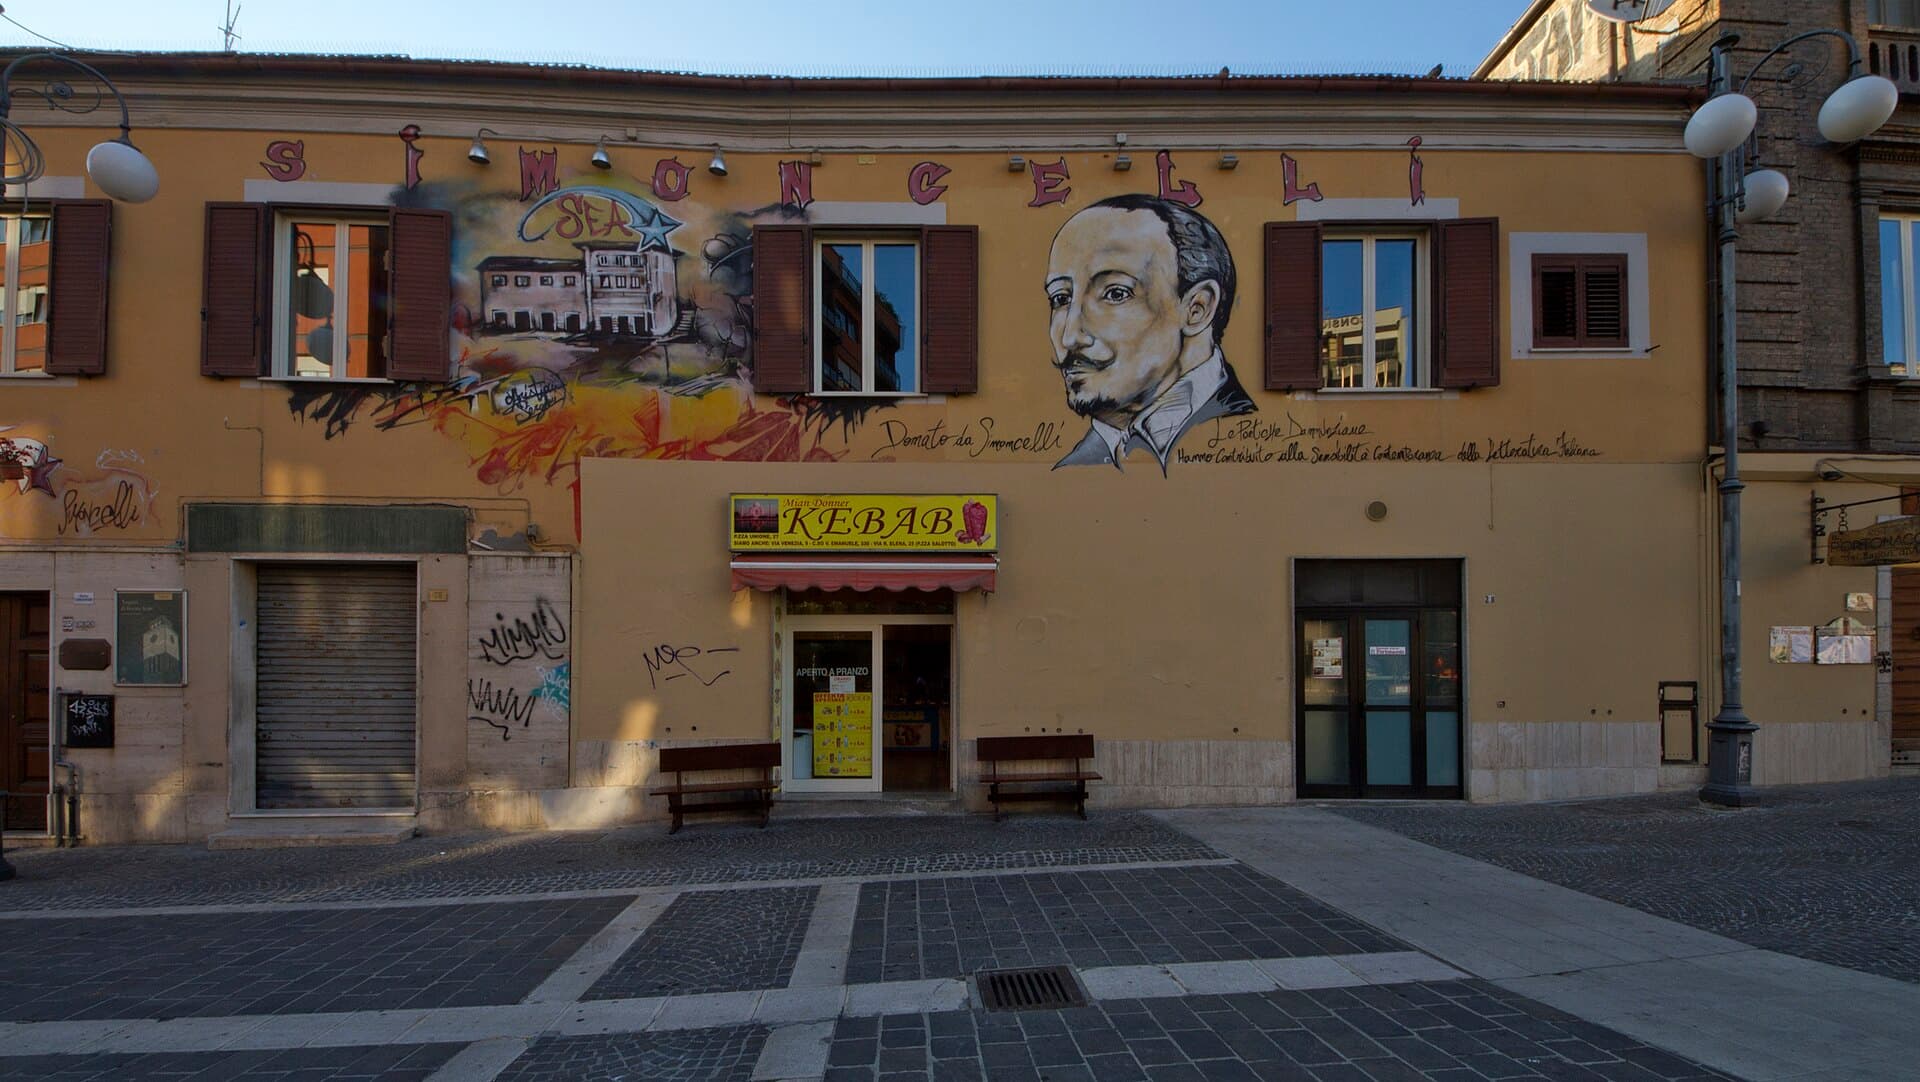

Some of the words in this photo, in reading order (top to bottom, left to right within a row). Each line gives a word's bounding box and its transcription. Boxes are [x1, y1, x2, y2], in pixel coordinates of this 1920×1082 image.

[555, 192, 633, 239] SEA
[872, 419, 949, 458] Donato
[953, 424, 974, 447] da
[970, 417, 1065, 457] Simoncelli
[1278, 441, 1306, 462] alla
[783, 498, 810, 508] Mian
[812, 498, 850, 508] Donner
[783, 507, 953, 540] KEBAB
[796, 667, 828, 677] APERTO
[829, 667, 836, 676] A
[836, 666, 869, 676] PRANZO
